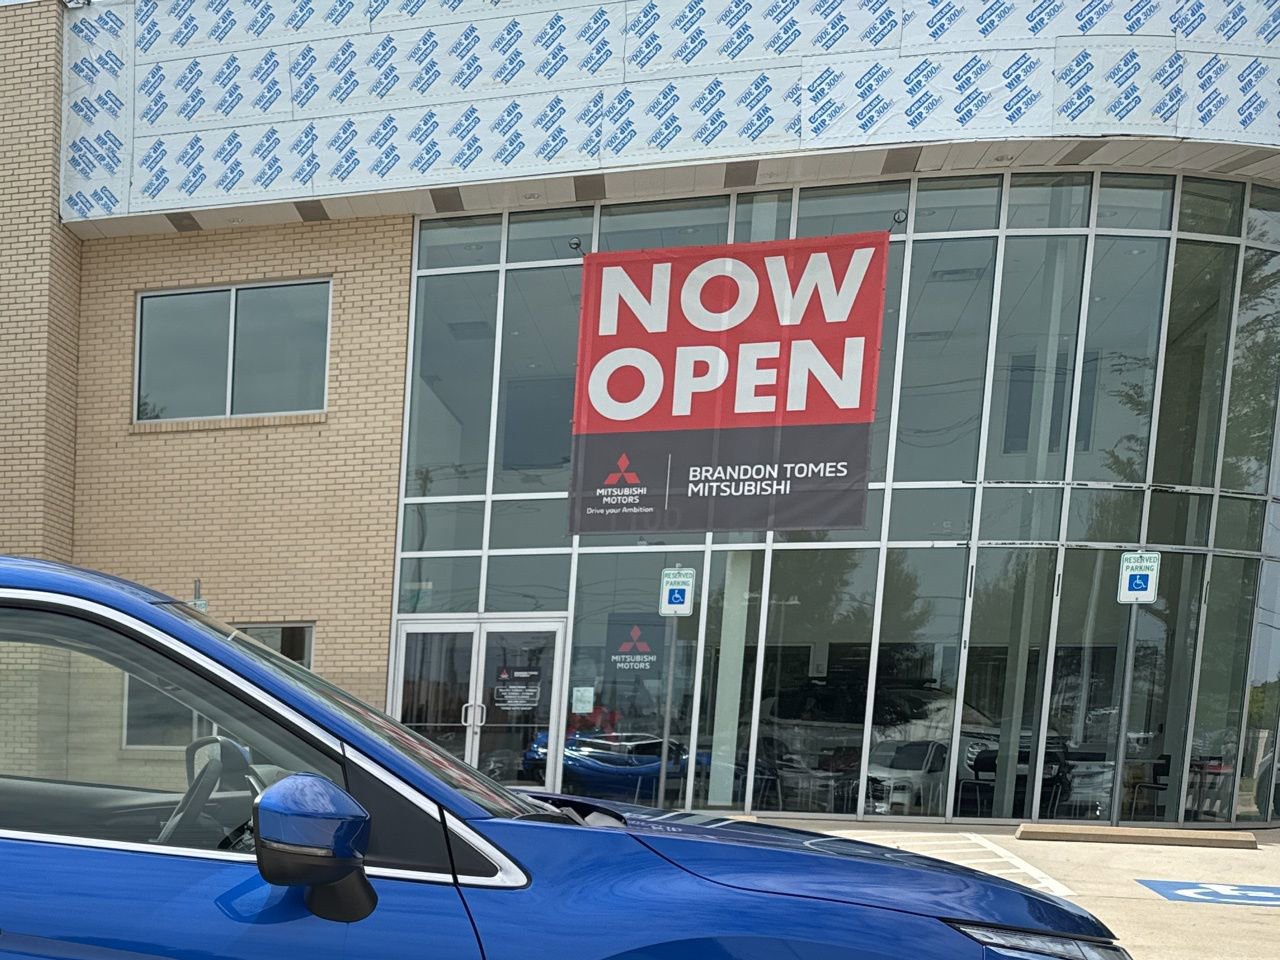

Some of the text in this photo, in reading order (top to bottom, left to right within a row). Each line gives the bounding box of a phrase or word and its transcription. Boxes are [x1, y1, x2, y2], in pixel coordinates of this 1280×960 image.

[598, 247, 875, 336] NOW
[588, 336, 865, 421] OPEN
[689, 462, 848, 480] BRANDON TOMES
[596, 487, 647, 496] MITSUBISHI
[688, 480, 791, 497] MITSUBISHI
[602, 496, 640, 504] MOTORS
[1125, 556, 1158, 564] RESERVED
[1125, 564, 1155, 572] PARKING
[664, 571, 693, 579] RESERVED
[665, 579, 691, 587] PARKING
